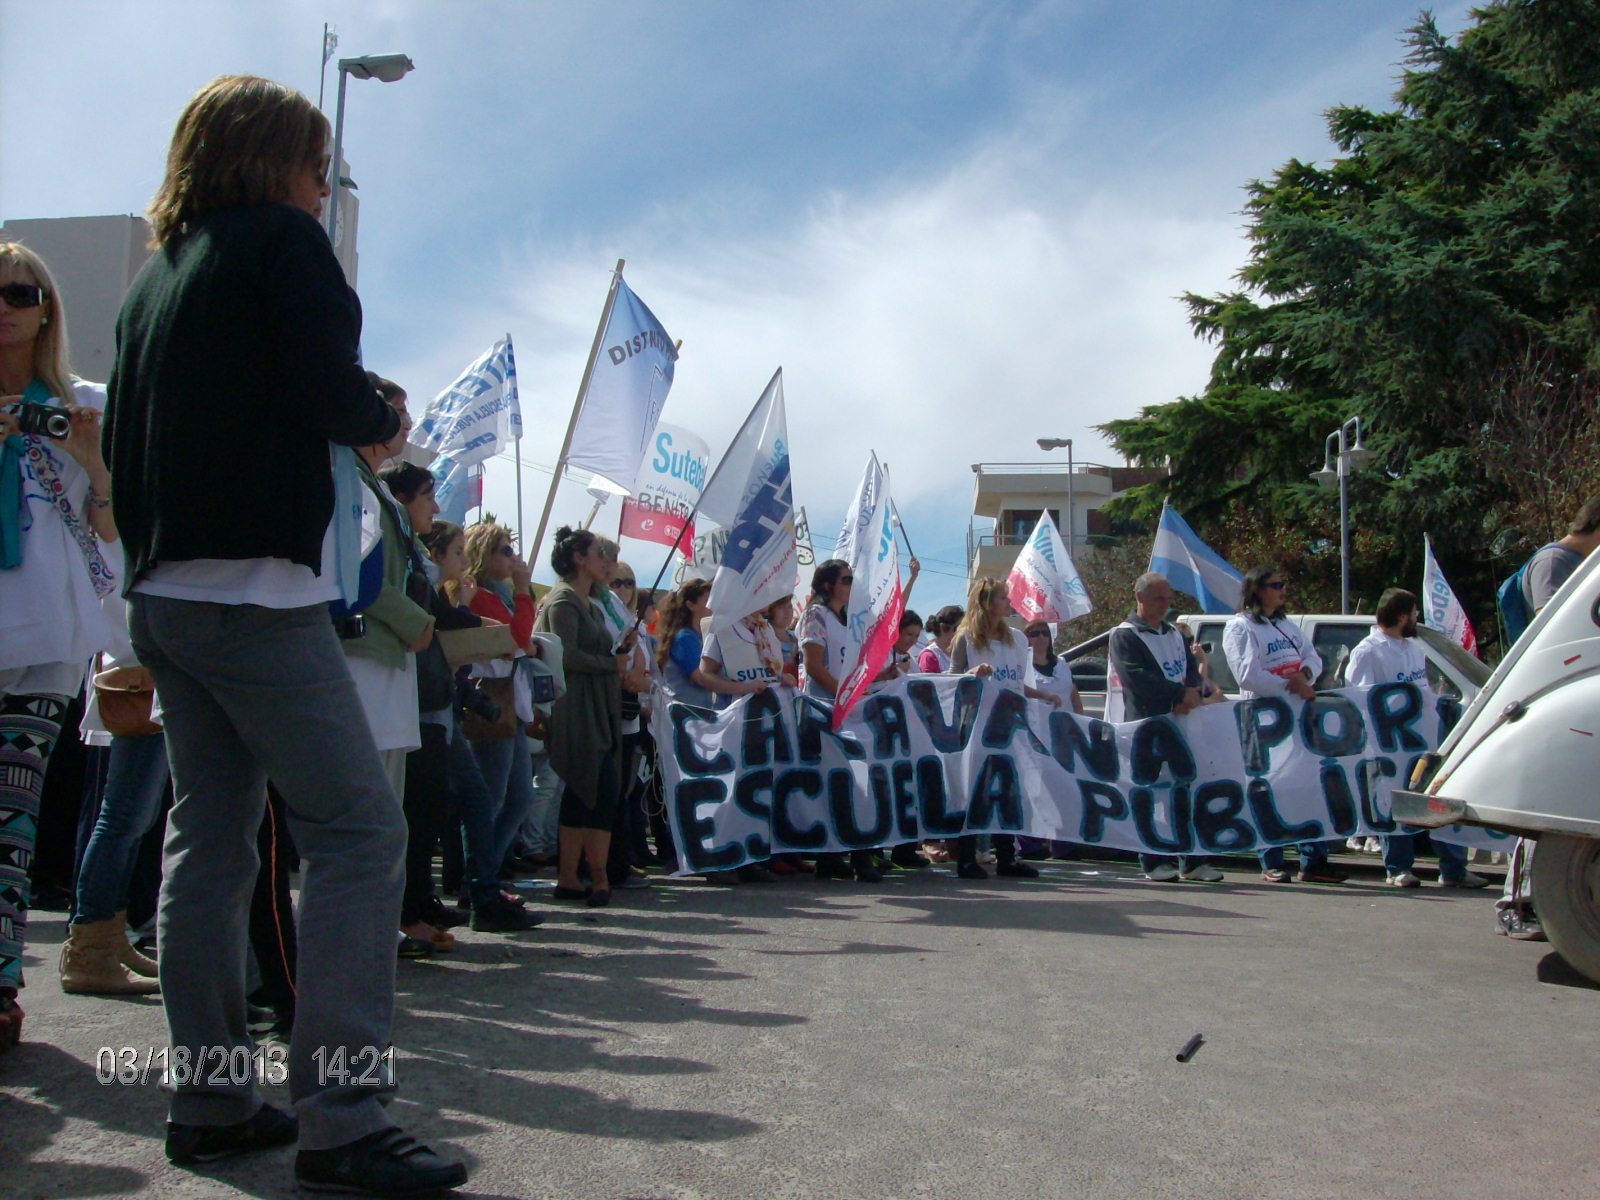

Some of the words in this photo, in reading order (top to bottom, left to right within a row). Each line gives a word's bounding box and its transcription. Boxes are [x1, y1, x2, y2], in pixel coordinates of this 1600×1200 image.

[737, 667, 773, 681] SUTE
[1234, 681, 1428, 777] POR
[675, 754, 1025, 872] ESCUELA
